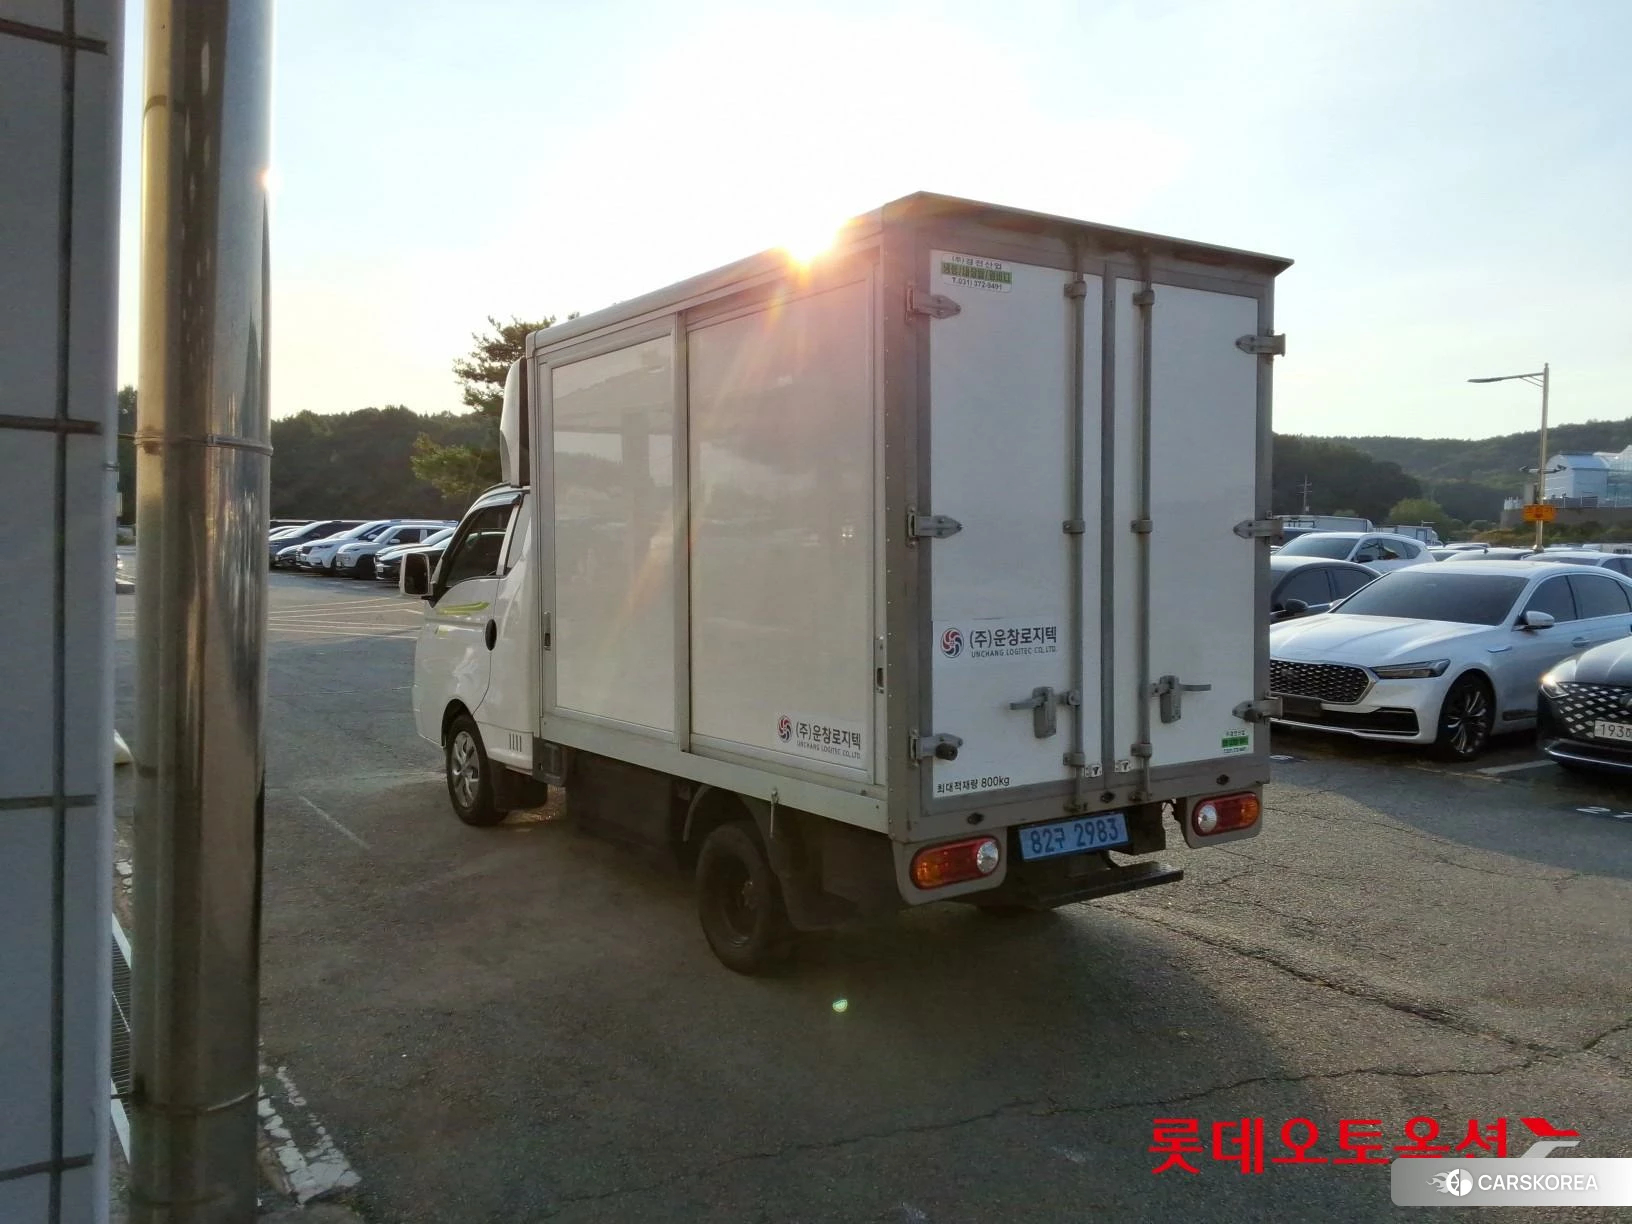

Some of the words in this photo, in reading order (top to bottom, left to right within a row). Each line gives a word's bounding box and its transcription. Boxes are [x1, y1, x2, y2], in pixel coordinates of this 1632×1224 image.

[969, 626, 1057, 649] (주)운창로지텍
[971, 649, 1005, 659] UNCHANG
[795, 721, 862, 751] (주)운창로지텍
[937, 778, 978, 794] 최대적재량
[980, 775, 1010, 788] 800kg
[1030, 827, 1066, 854] 82구
[1074, 818, 1118, 848] 2983
